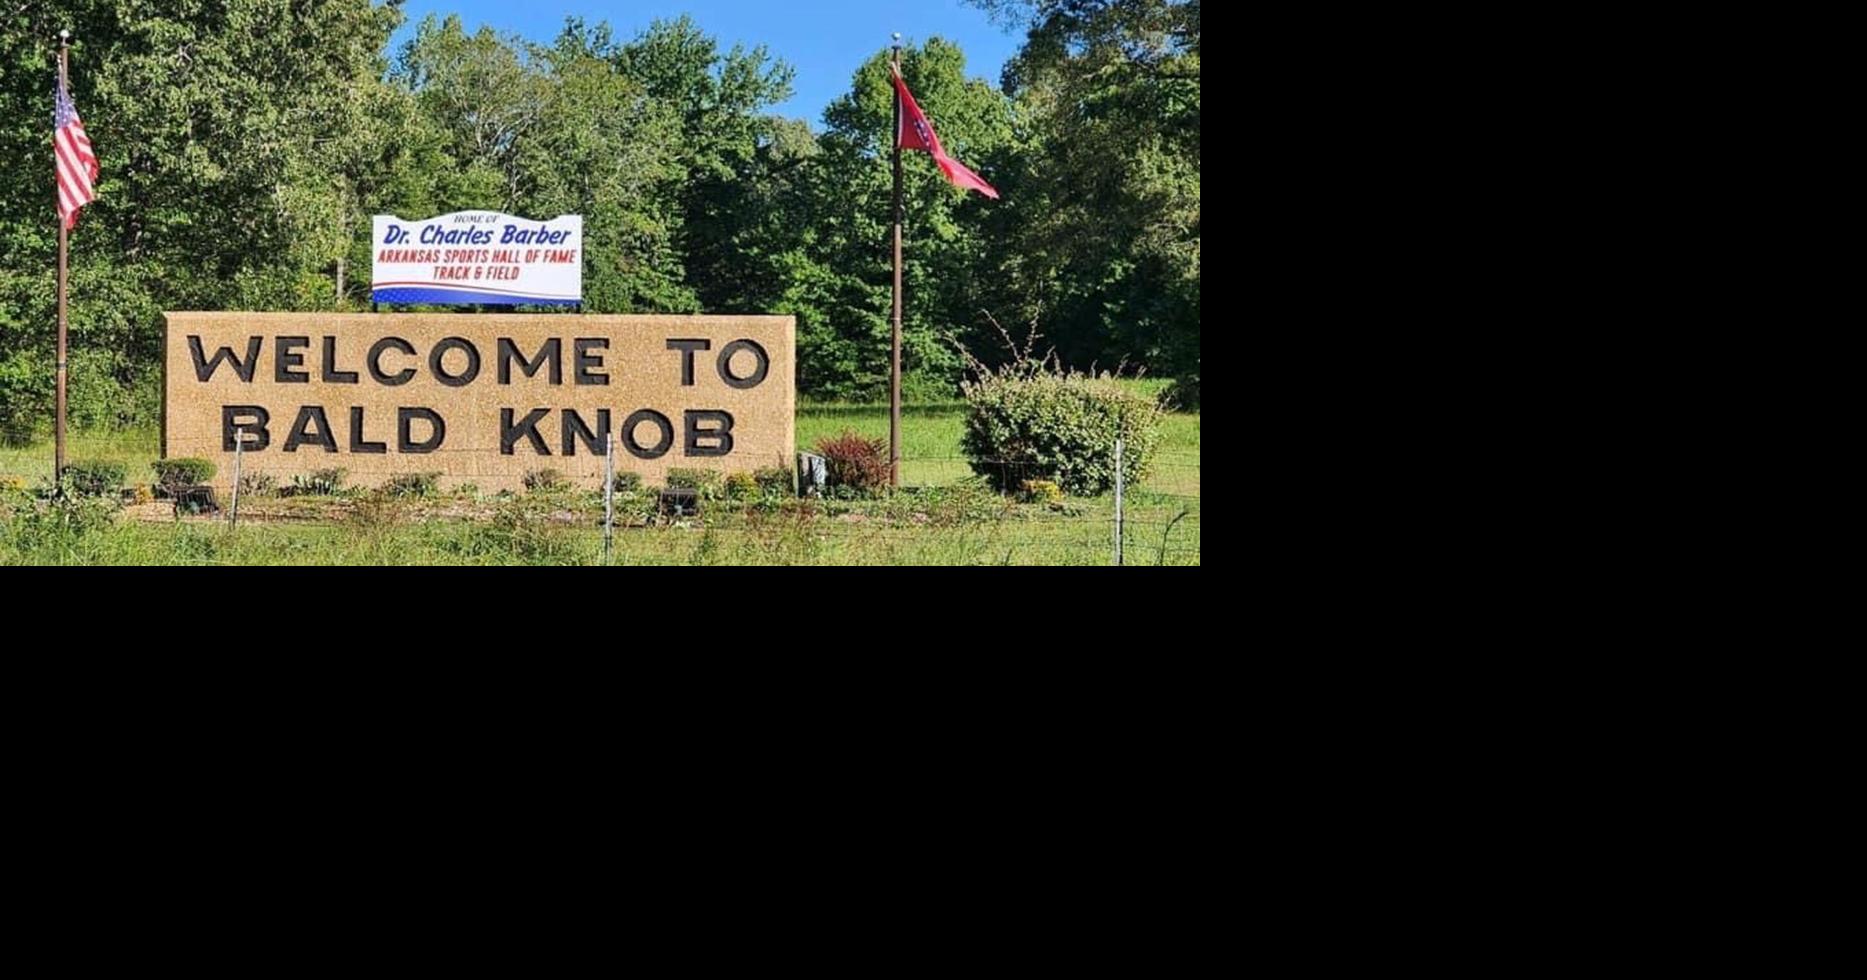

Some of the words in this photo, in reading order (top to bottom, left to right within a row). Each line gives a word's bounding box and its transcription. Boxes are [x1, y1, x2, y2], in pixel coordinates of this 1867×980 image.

[454, 215, 482, 223] HOME
[485, 215, 498, 223] OF
[384, 225, 409, 244] Dr.
[420, 225, 493, 244] Charles
[501, 225, 571, 244] Barber
[378, 249, 439, 263] ARKANSAS
[443, 249, 488, 263] SPORTS
[492, 249, 520, 263] HALL
[525, 249, 540, 263] OF
[543, 249, 576, 263] FAME
[433, 266, 470, 279] TRACK
[474, 266, 482, 279] &
[486, 266, 520, 279] FIELD
[187, 335, 609, 387] WELCOME
[666, 338, 770, 389] TO
[222, 405, 446, 453] BALD
[500, 408, 734, 459] KNOB
